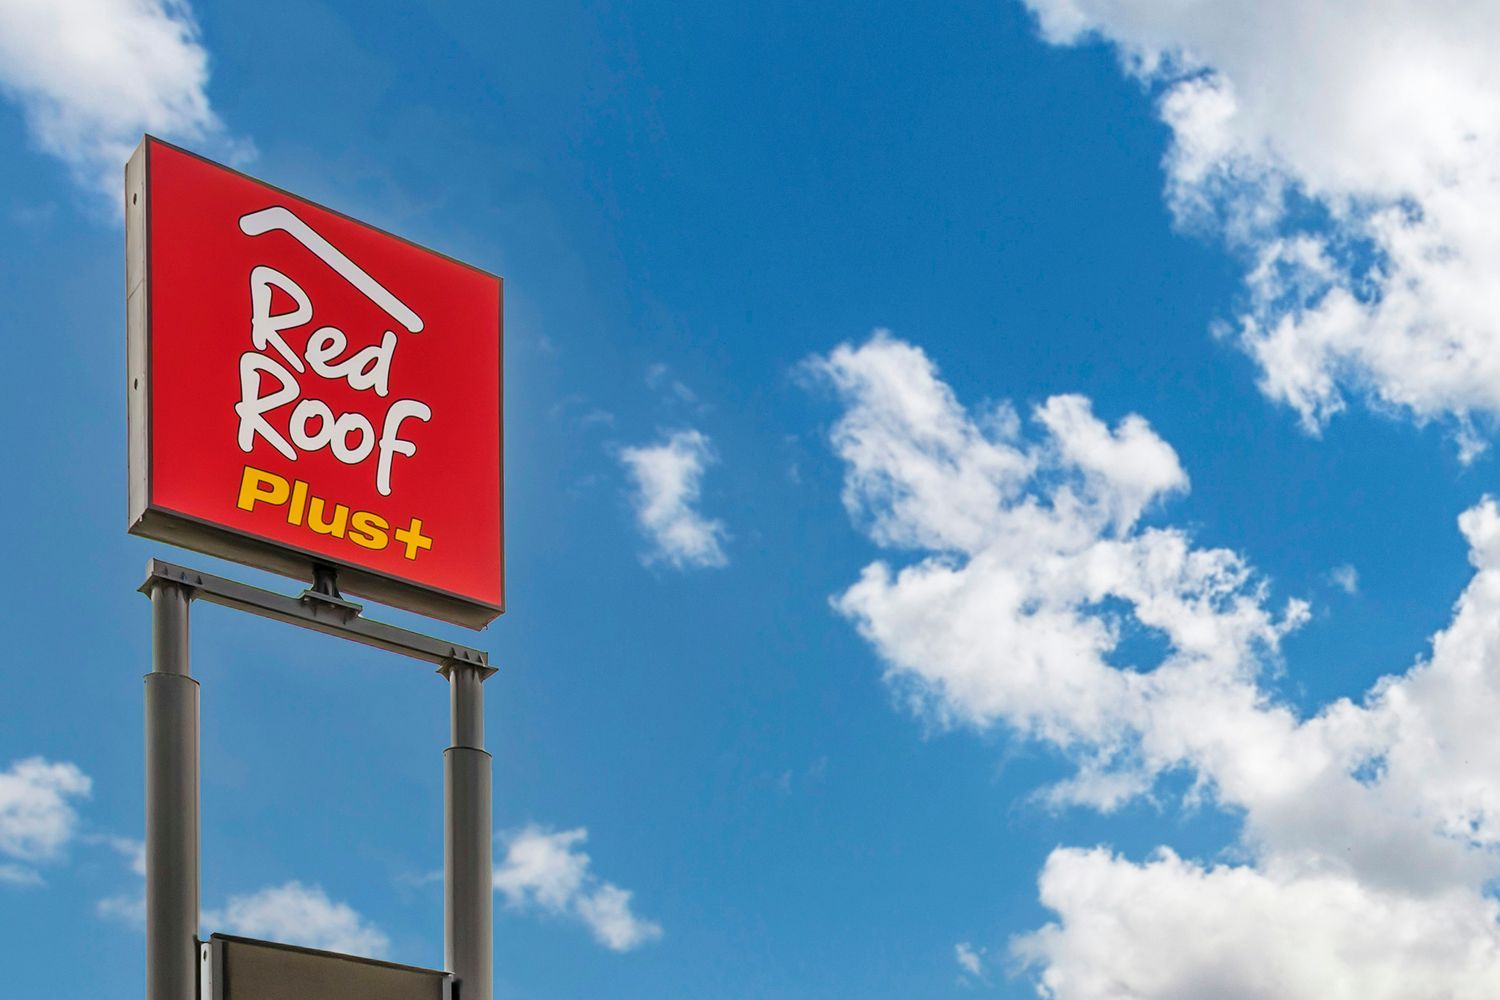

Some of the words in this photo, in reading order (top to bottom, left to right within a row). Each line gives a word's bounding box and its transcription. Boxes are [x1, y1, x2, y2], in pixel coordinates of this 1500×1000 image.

[250, 265, 397, 397] Red
[235, 351, 432, 497] Roof
[236, 465, 433, 561] Plus+
